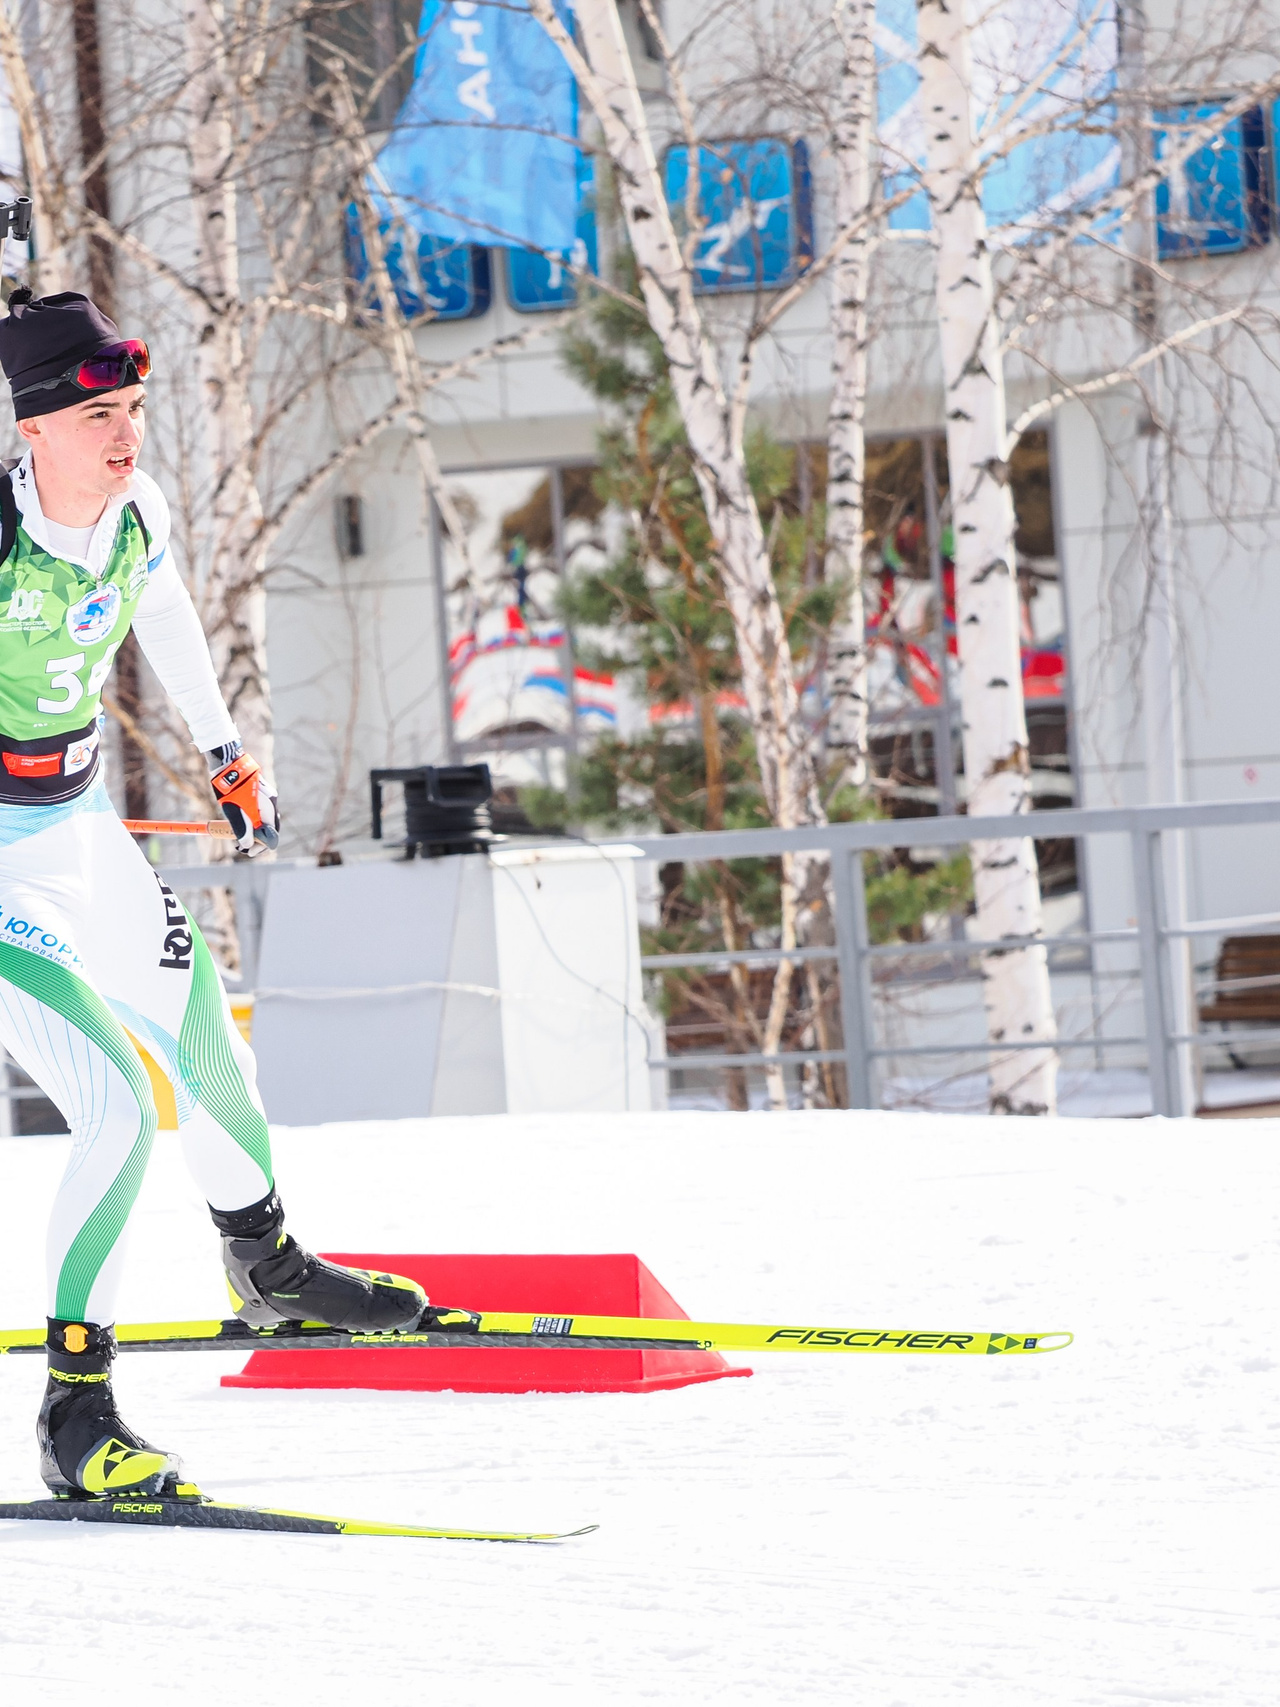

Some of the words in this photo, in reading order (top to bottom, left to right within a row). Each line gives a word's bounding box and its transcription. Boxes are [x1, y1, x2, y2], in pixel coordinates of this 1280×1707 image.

[350, 1334, 429, 1344] FISCHER
[766, 1329, 974, 1350] FISCHER
[112, 1503, 163, 1514] FISCHER
